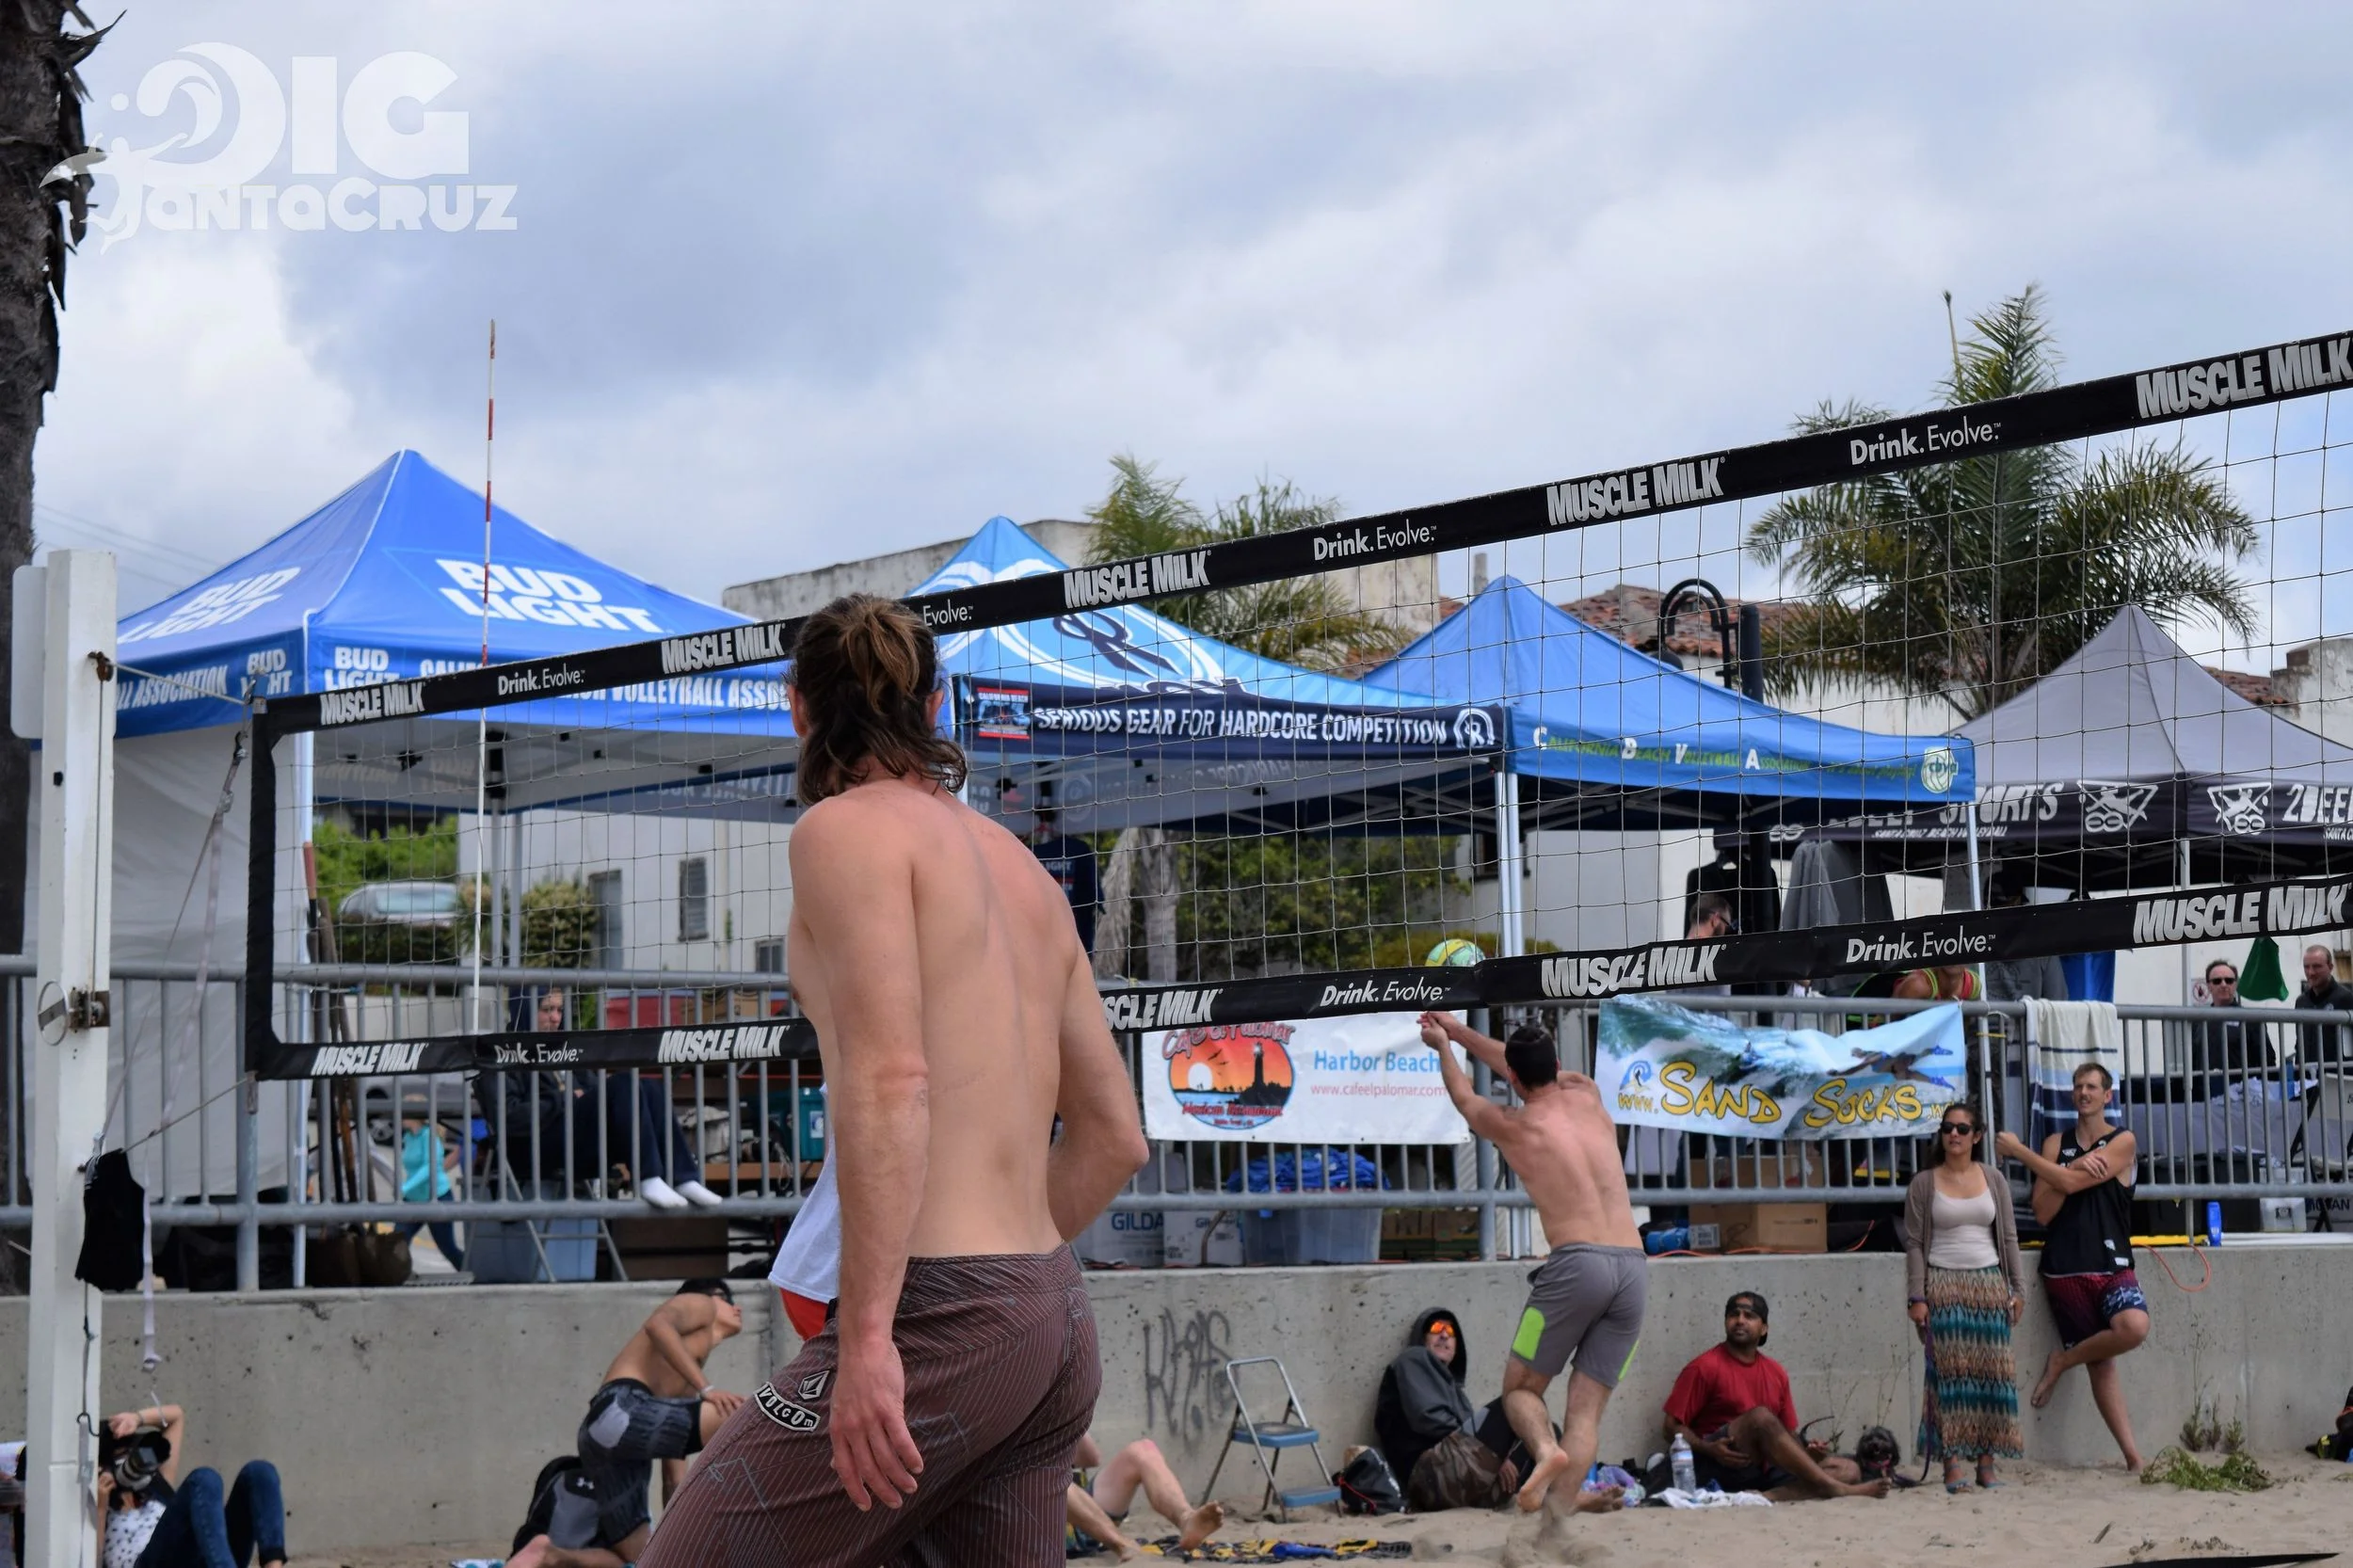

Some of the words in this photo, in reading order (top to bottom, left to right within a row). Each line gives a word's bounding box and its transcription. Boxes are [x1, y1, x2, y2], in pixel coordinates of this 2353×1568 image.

[2136, 355, 2265, 419] MUSCLE
[2267, 338, 2353, 395] MILK
[1850, 428, 1924, 466] Drink.
[1546, 471, 1650, 526] MUSCLE
[1653, 456, 1724, 506] MILK
[1314, 527, 1374, 561] Drink.
[435, 558, 602, 603] BUD
[1064, 562, 1150, 609] MUSCLE
[1152, 550, 1210, 594] MILK
[439, 587, 664, 633] LIGHT
[247, 648, 286, 677] BUD
[334, 646, 390, 672] BUD
[662, 632, 735, 674] MUSCLE
[734, 624, 785, 663] MILK
[133, 664, 228, 709] ASSOCIATION
[241, 669, 293, 696] LHT
[324, 668, 400, 693] LIG
[498, 669, 541, 696] Drink.
[320, 688, 382, 726] MUSCLE
[383, 681, 425, 717] MILK
[1035, 707, 1122, 732] SERIOUS
[1127, 708, 1176, 736] GEAR
[1178, 709, 1215, 736] FOR
[1219, 710, 1317, 741] HARDCORE
[1321, 713, 1448, 744] COMPETITION
[1939, 782, 2064, 824] SORTS
[2282, 783, 2353, 824] 2DEE
[1958, 824, 2008, 839] VLEYBALL
[2132, 890, 2261, 944] MUSCLE
[2267, 884, 2348, 932] MILK
[1847, 936, 1917, 964] Drink.
[1542, 947, 1645, 998] MUSCLE
[1647, 944, 1721, 987] MILK
[1101, 993, 1159, 1031] SCLE
[1157, 988, 1219, 1027] MILK
[1320, 979, 1379, 1007] Drink.
[311, 1045, 380, 1076] MUSCLE
[376, 1043, 426, 1073] MILK
[657, 1029, 735, 1064] MUSCLE
[732, 1025, 787, 1060] MILK
[1314, 1049, 1381, 1072] Harbor
[1385, 1050, 1442, 1073] Beach
[1659, 1061, 1783, 1124] SAND
[1803, 1078, 1923, 1128] SOCKS
